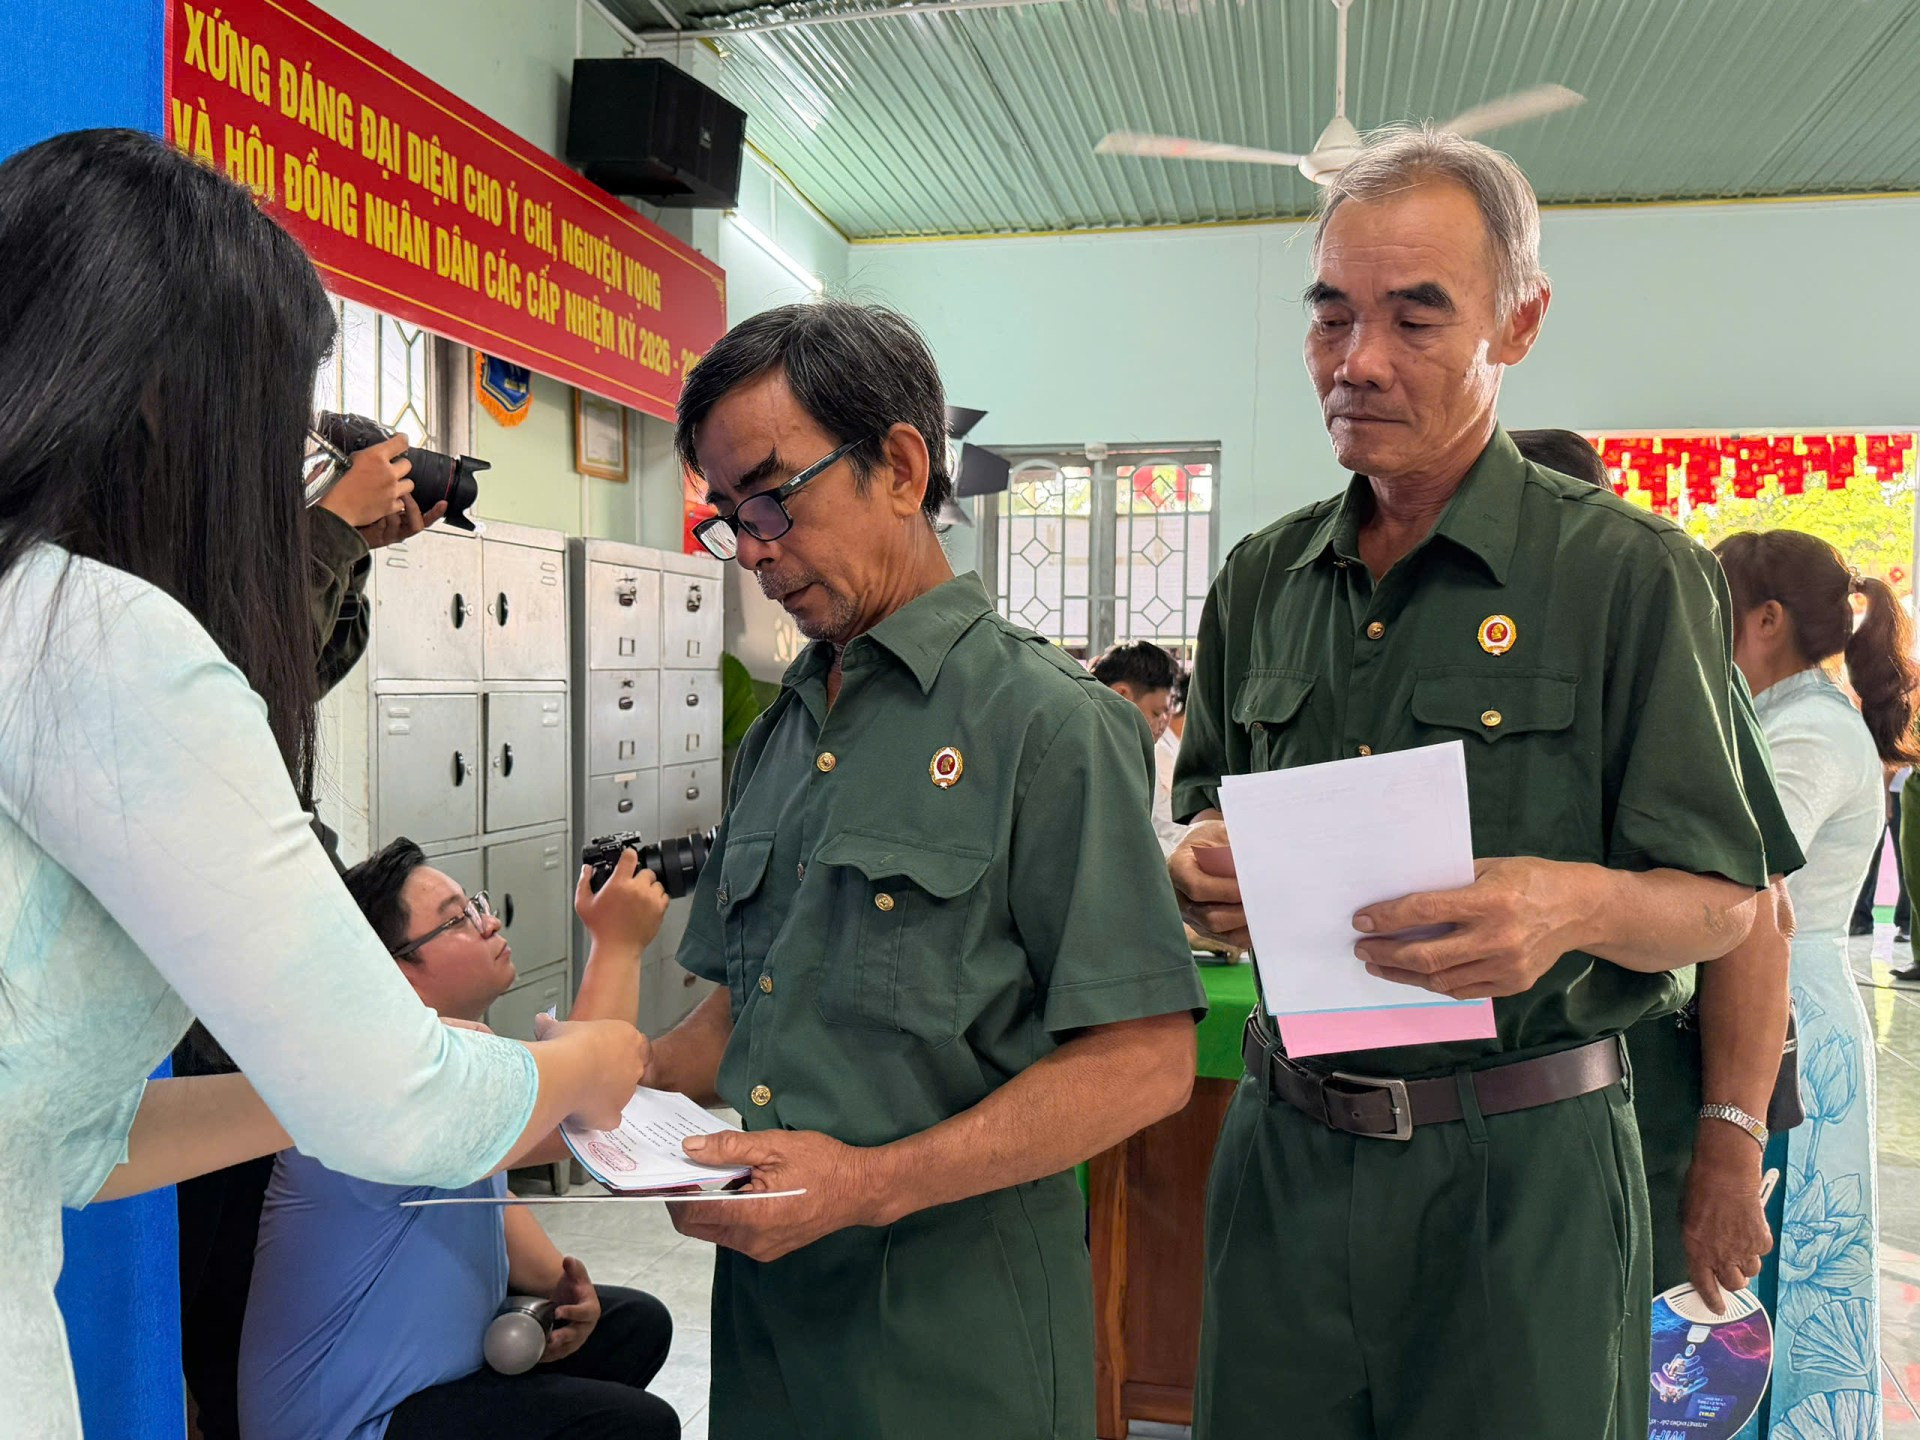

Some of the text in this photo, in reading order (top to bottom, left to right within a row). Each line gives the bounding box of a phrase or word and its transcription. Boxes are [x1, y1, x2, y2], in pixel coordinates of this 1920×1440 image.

[172, 96, 215, 168] VÀ
[283, 146, 358, 239] ĐỒNG
[365, 191, 430, 271] NHÂN
[436, 224, 479, 293] DÂN
[484, 248, 522, 310] CÁC
[526, 264, 561, 325] CẤP
[564, 289, 615, 354] NHIỆM
[618, 312, 636, 361] KỲ
[639, 327, 671, 377] 2026
[680, 348, 702, 382] 20
[184, 2, 662, 312] XỨNG ĐÁNG ĐẠI DIỆN CHO Ý CHÍ, NGUYỆN VỌNG
